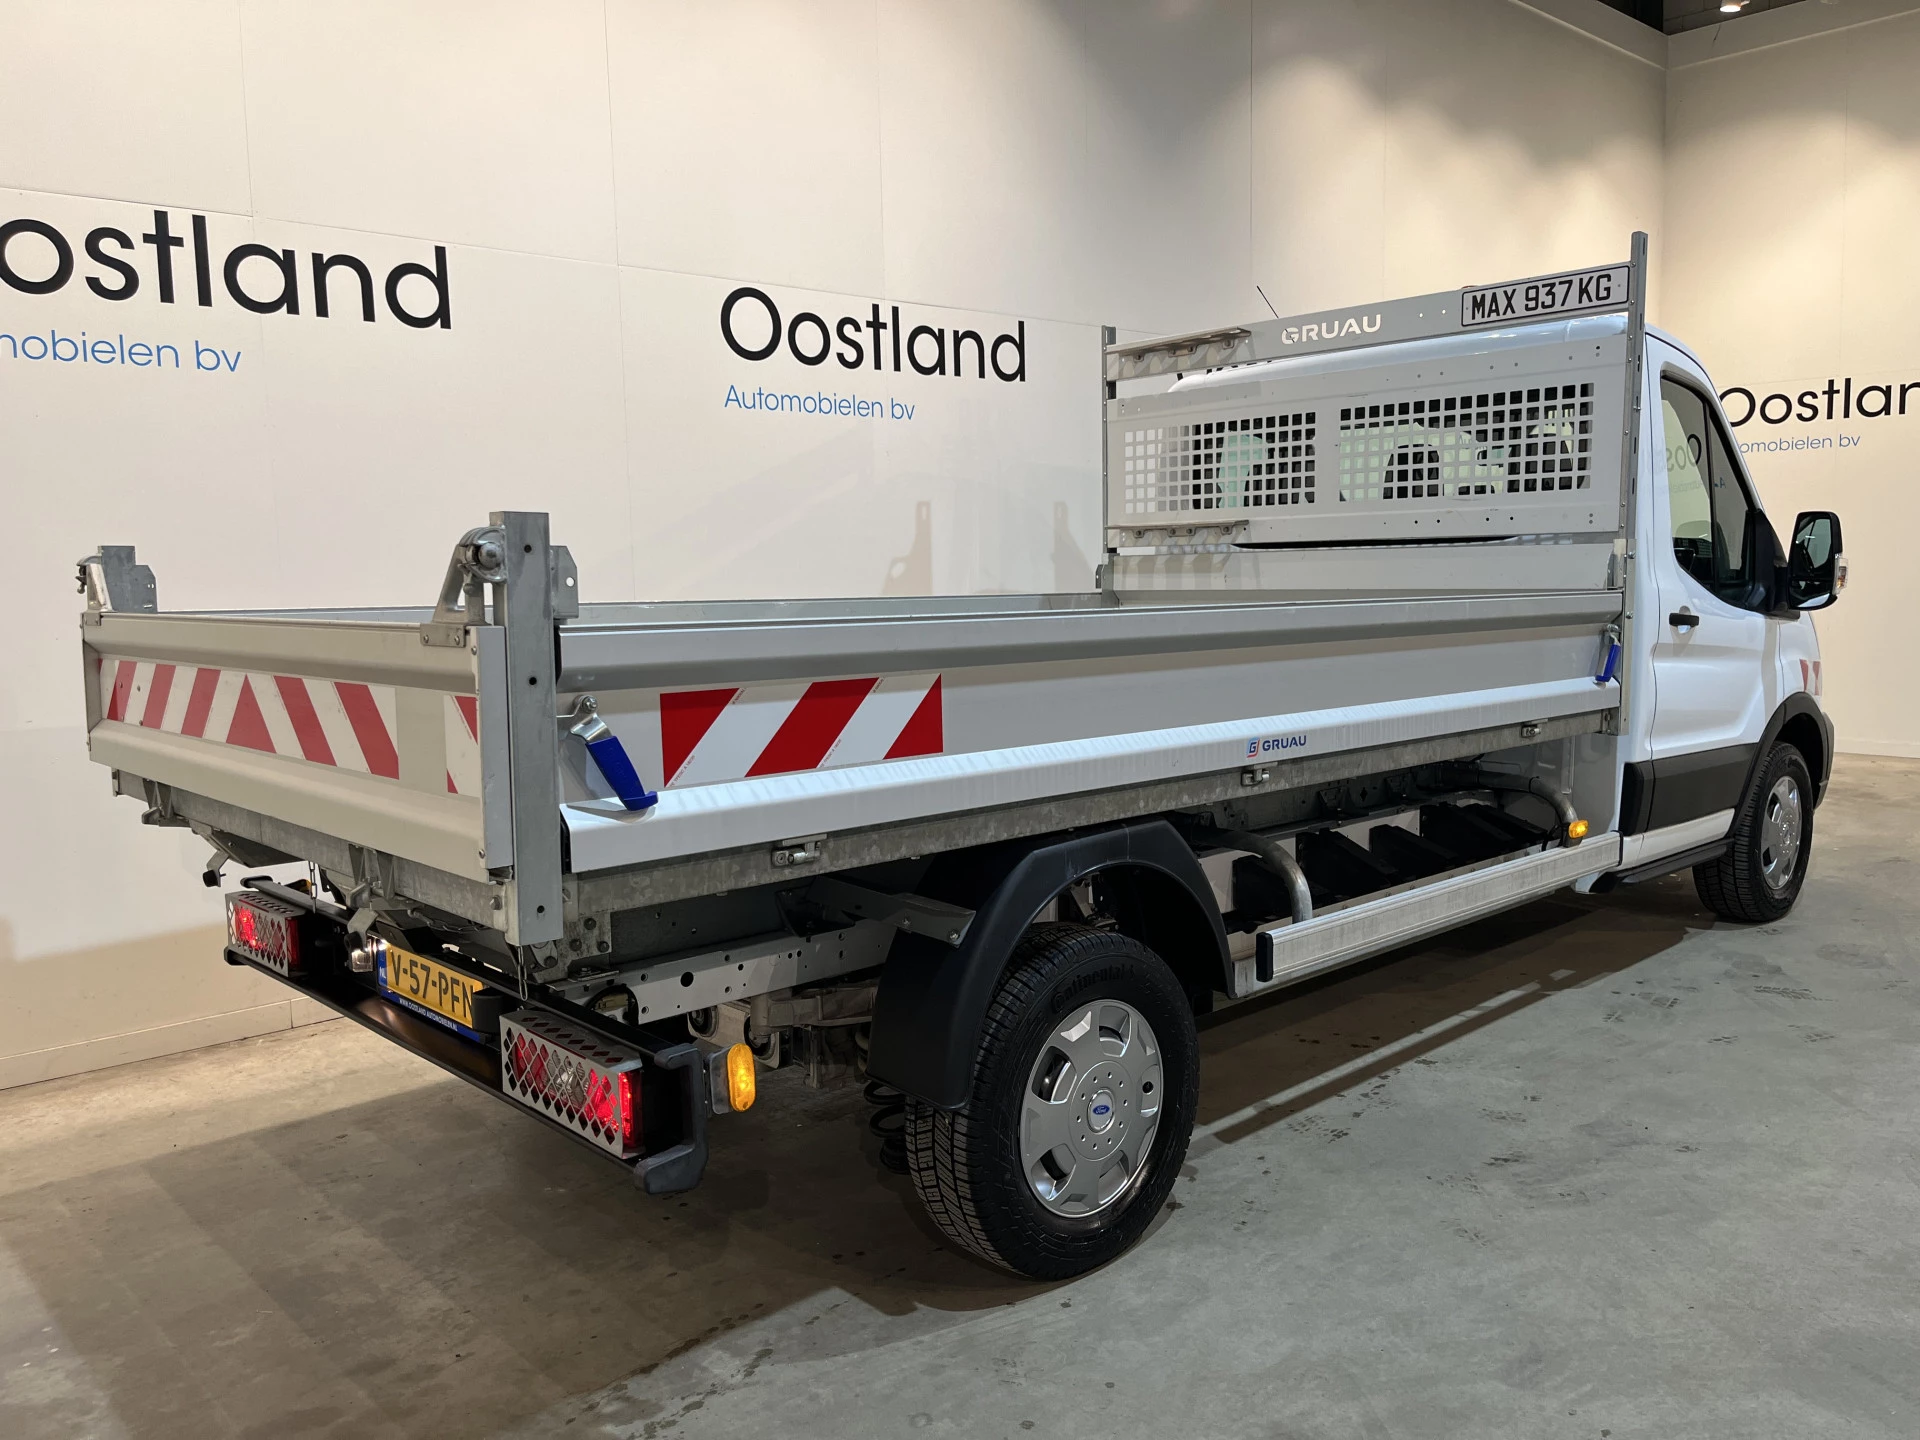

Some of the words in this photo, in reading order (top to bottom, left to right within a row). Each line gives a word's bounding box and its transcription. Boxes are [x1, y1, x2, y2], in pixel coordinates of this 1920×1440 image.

[1471, 288, 1517, 320] MAX
[1524, 279, 1573, 312] 937
[1578, 273, 1612, 304] KG
[721, 287, 1026, 382] Oostland
[1281, 314, 1381, 345] GRUAU
[194, 340, 242, 372] bv
[724, 384, 884, 418] Automobielen
[890, 397, 916, 420] bv
[1839, 433, 1861, 447] bv
[1262, 735, 1307, 752] GRUAU
[379, 966, 387, 979] NL
[391, 950, 474, 1019] V-57-PFN
